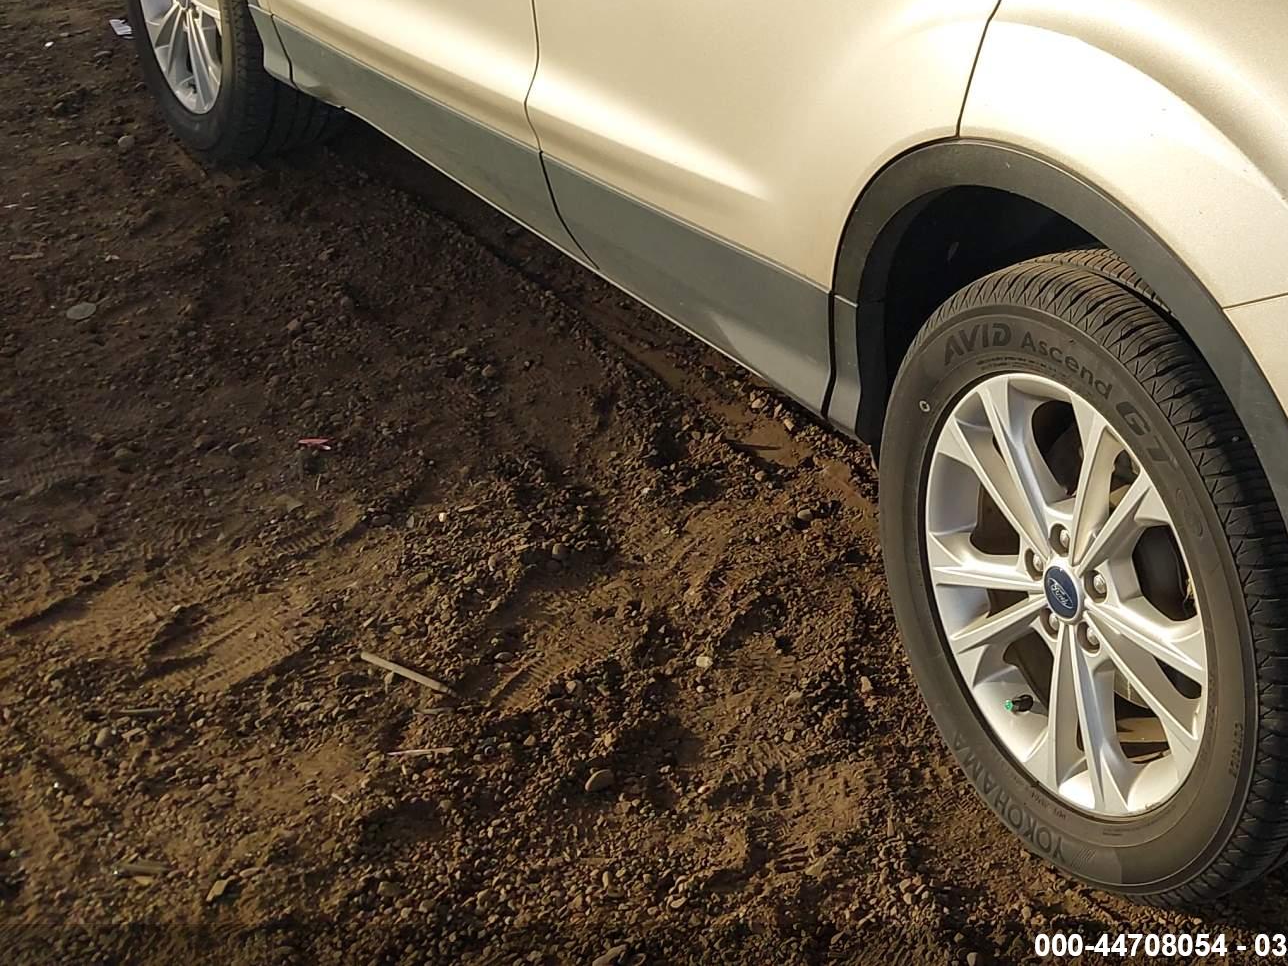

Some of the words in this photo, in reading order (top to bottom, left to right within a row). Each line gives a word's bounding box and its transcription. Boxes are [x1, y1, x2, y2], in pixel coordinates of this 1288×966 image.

[944, 322, 1012, 366] AVID
[1021, 331, 1112, 400] Ascend
[1115, 400, 1182, 472] GT
[952, 731, 1066, 864] YOKOHAMA
